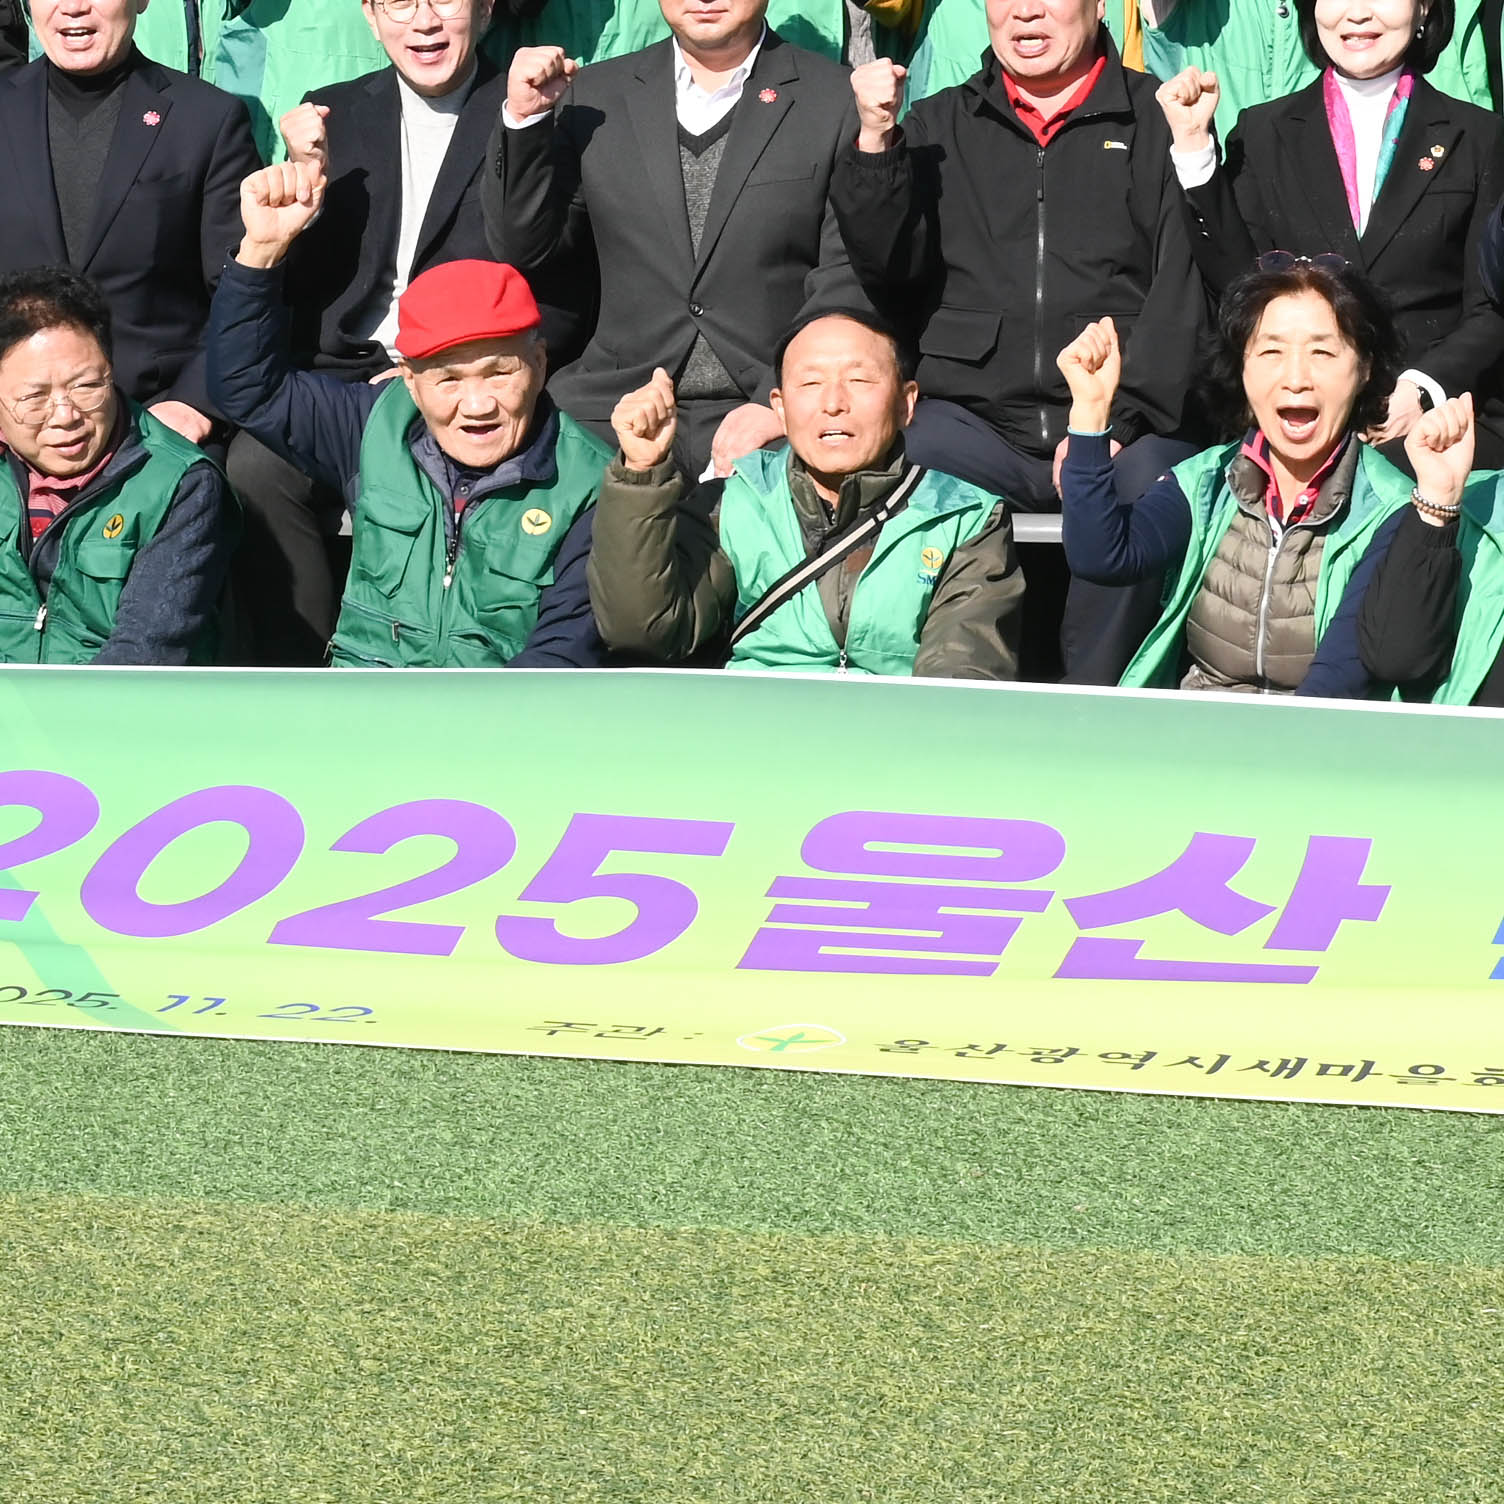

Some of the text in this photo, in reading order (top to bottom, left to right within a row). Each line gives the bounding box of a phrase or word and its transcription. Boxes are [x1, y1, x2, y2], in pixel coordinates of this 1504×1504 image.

[917, 572, 937, 586] SM
[157, 993, 227, 1017] 11.
[258, 1002, 377, 1025] 22.
